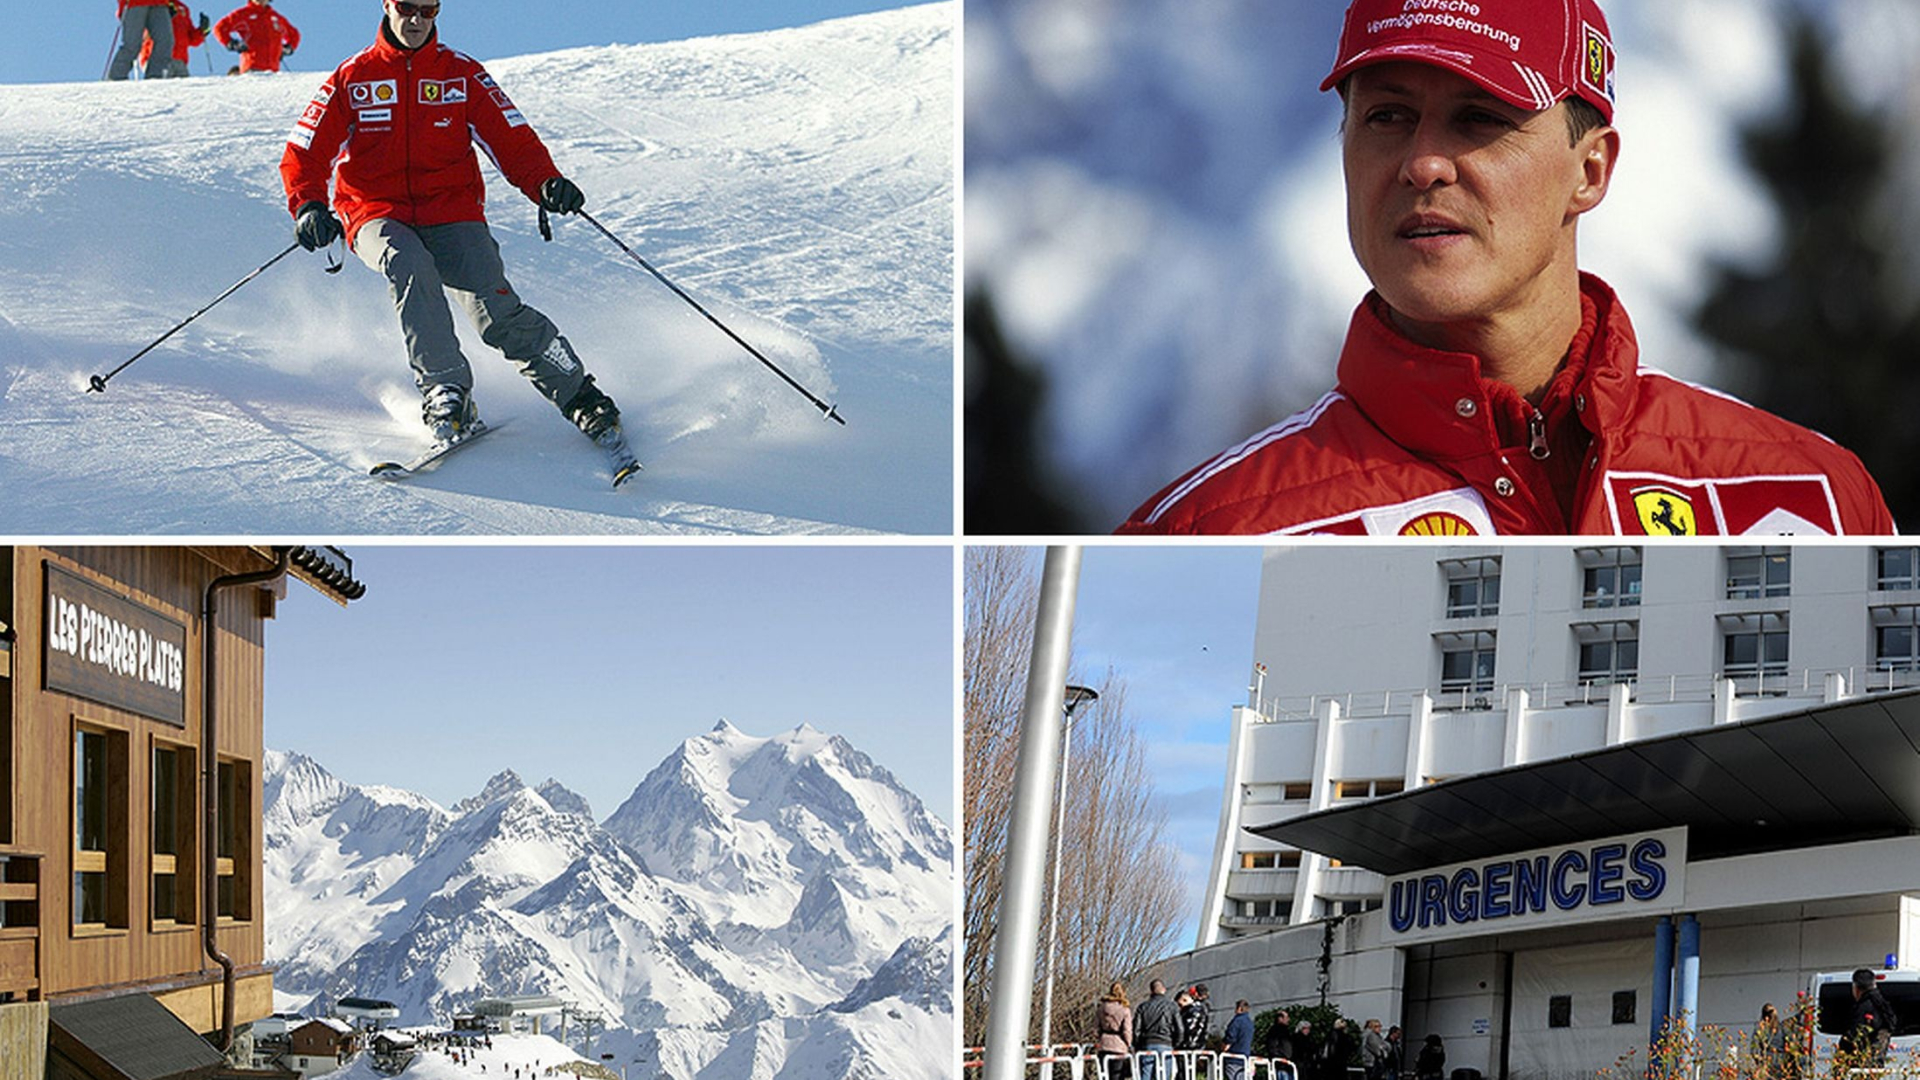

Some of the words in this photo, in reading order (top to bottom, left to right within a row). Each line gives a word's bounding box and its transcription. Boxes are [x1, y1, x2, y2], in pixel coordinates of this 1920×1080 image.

[1403, 0, 1480, 16] Deutsche
[51, 594, 78, 656] LES
[81, 603, 137, 677] PIERRES
[139, 628, 183, 692] PLATES
[1389, 838, 1667, 932] URGENCES
